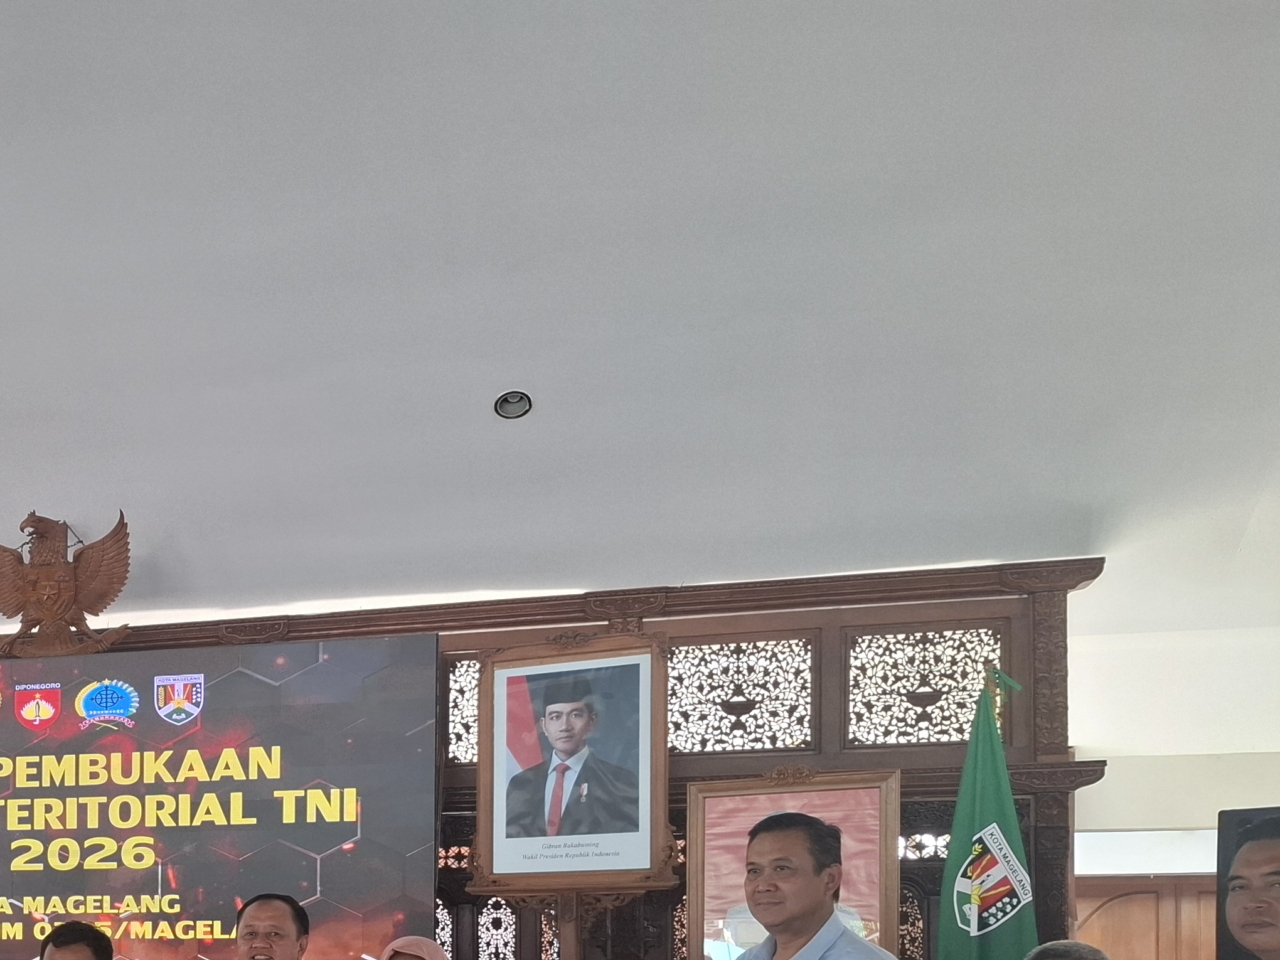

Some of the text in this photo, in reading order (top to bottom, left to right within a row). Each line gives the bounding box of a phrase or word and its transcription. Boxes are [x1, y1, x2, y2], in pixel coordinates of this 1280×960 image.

[15, 682, 61, 691] DIPONEGORO
[273, 788, 357, 824] TNI
[10, 836, 156, 872] 2026
[988, 831, 1031, 896] KOTA MAGELANG
[23, 894, 181, 914] MAGELANG
